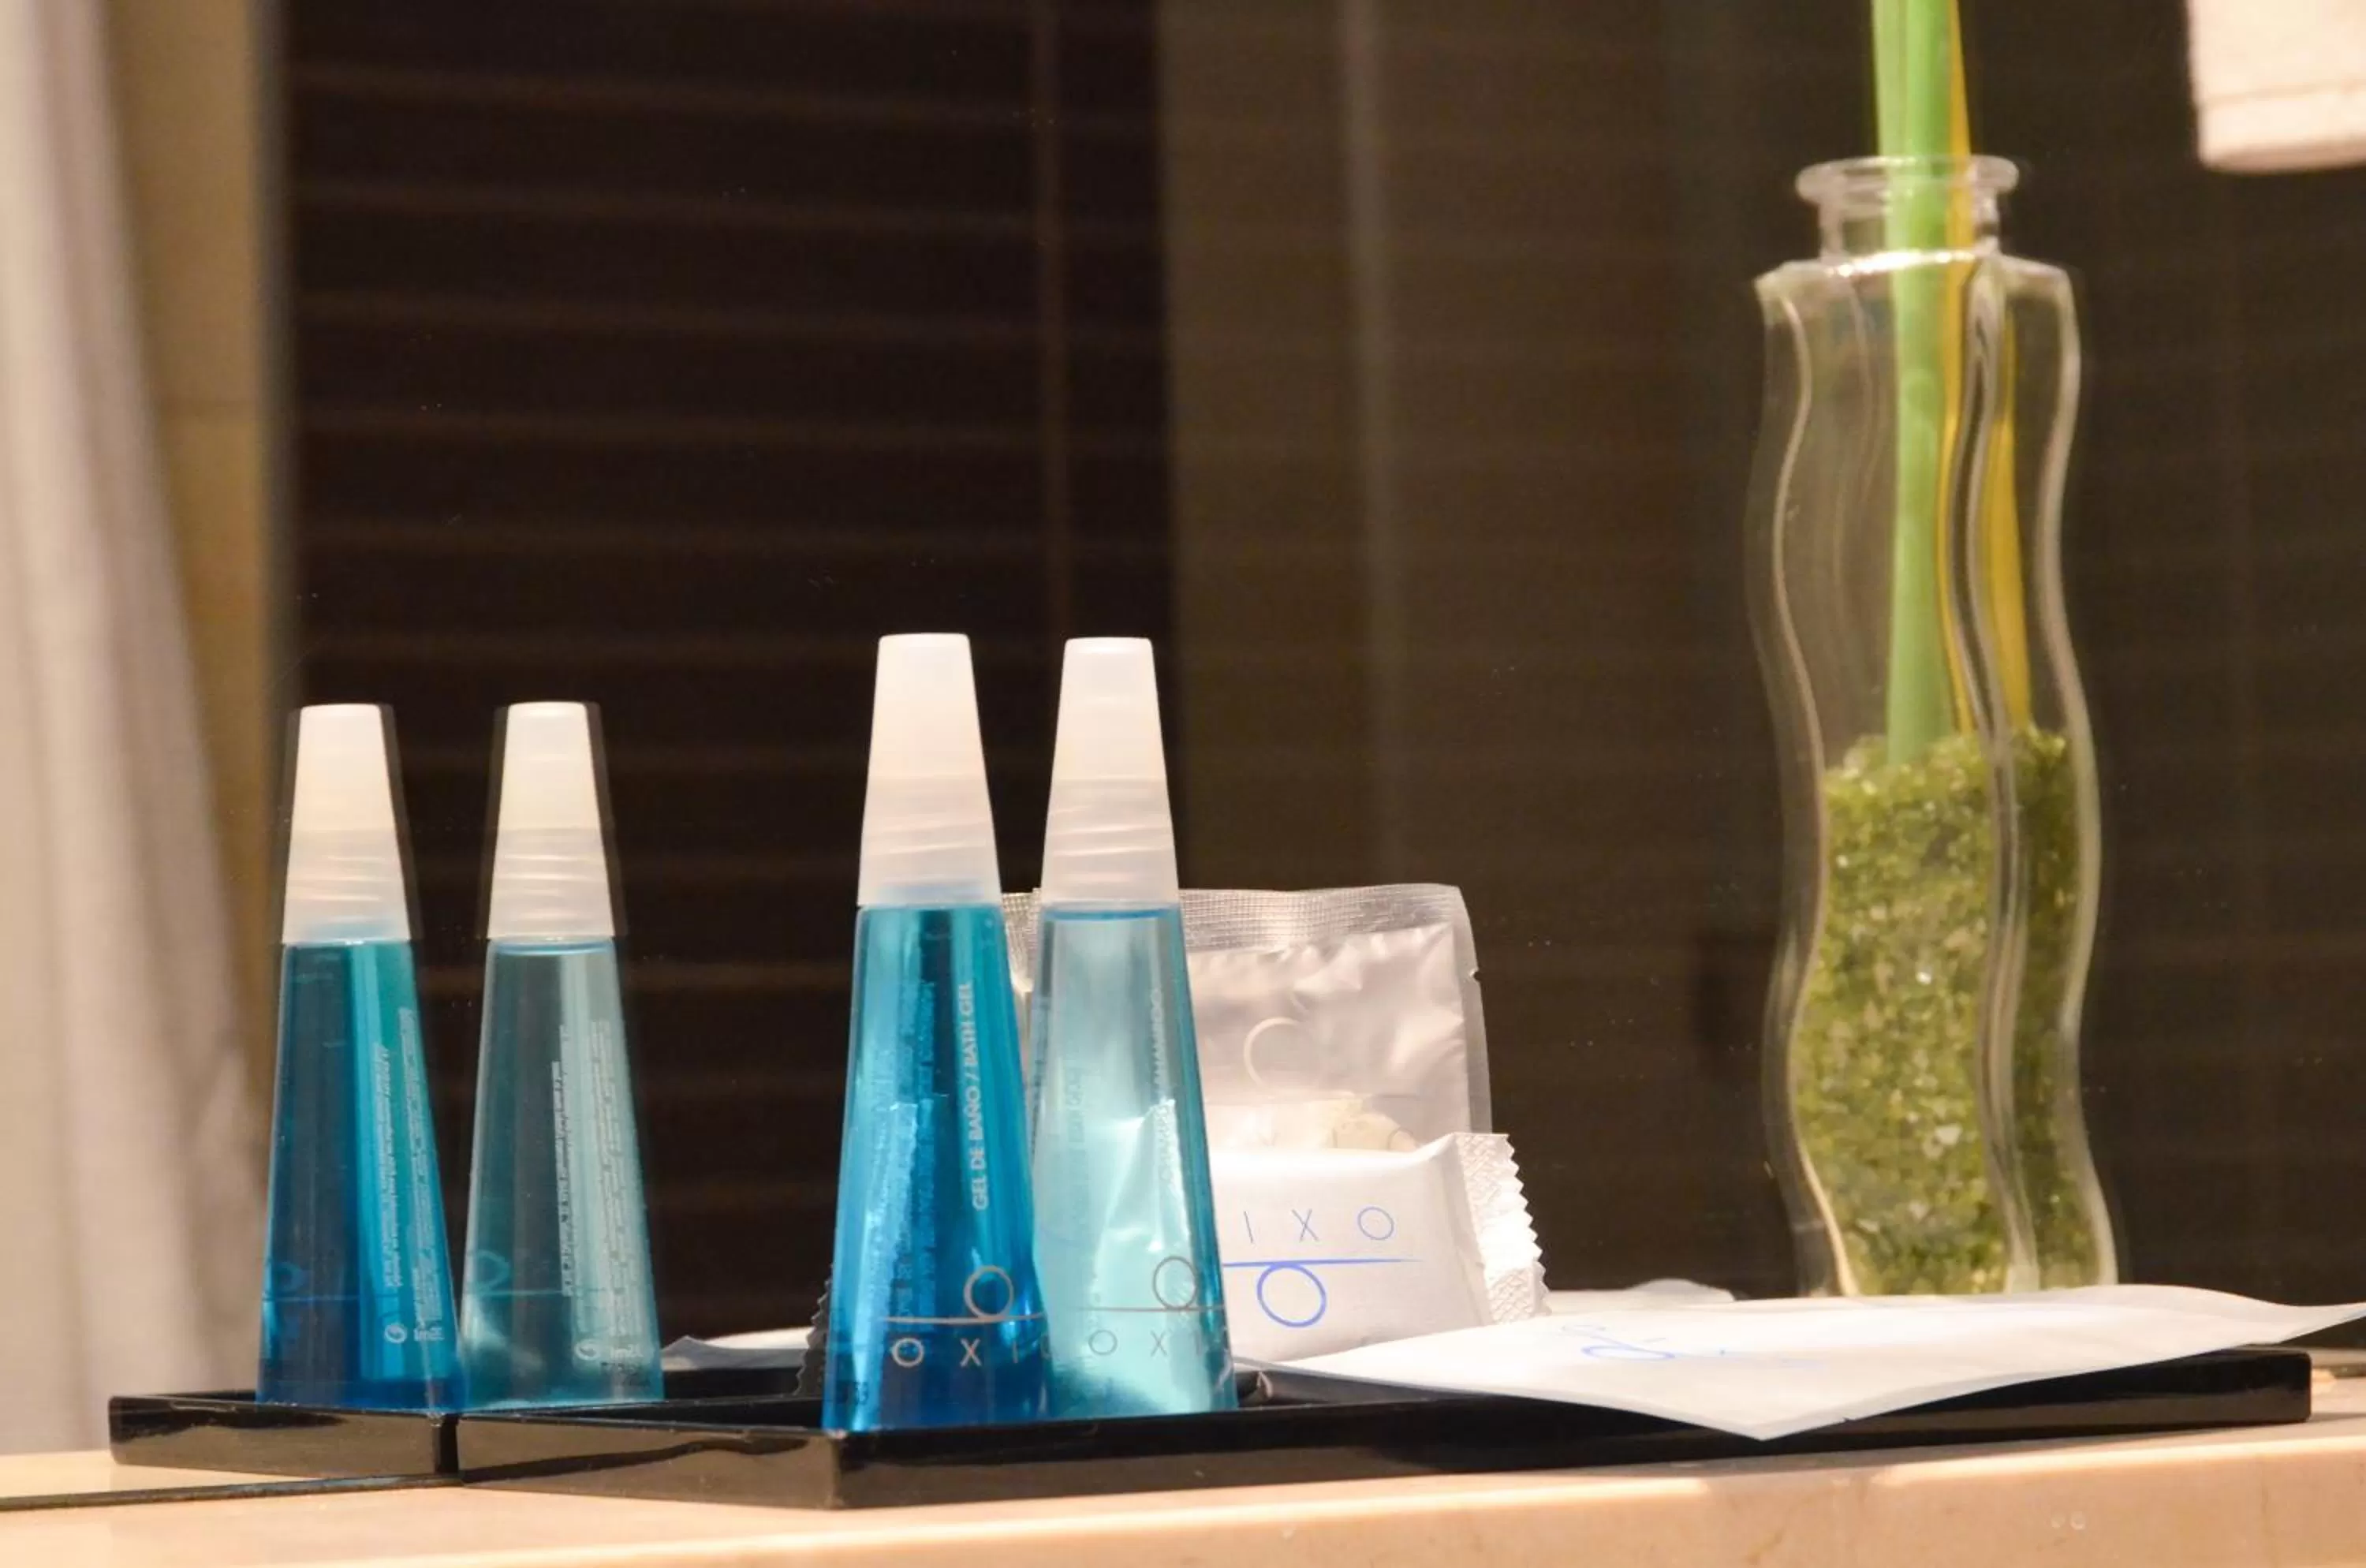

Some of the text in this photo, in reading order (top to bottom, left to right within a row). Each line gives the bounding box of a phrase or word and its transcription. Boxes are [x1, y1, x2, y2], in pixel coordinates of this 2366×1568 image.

[957, 980, 975, 1017] GEL
[960, 1020, 980, 1068] BATH
[962, 1085, 983, 1141] BAÑO
[969, 1146, 986, 1171] DE
[971, 1174, 990, 1211] GEL
